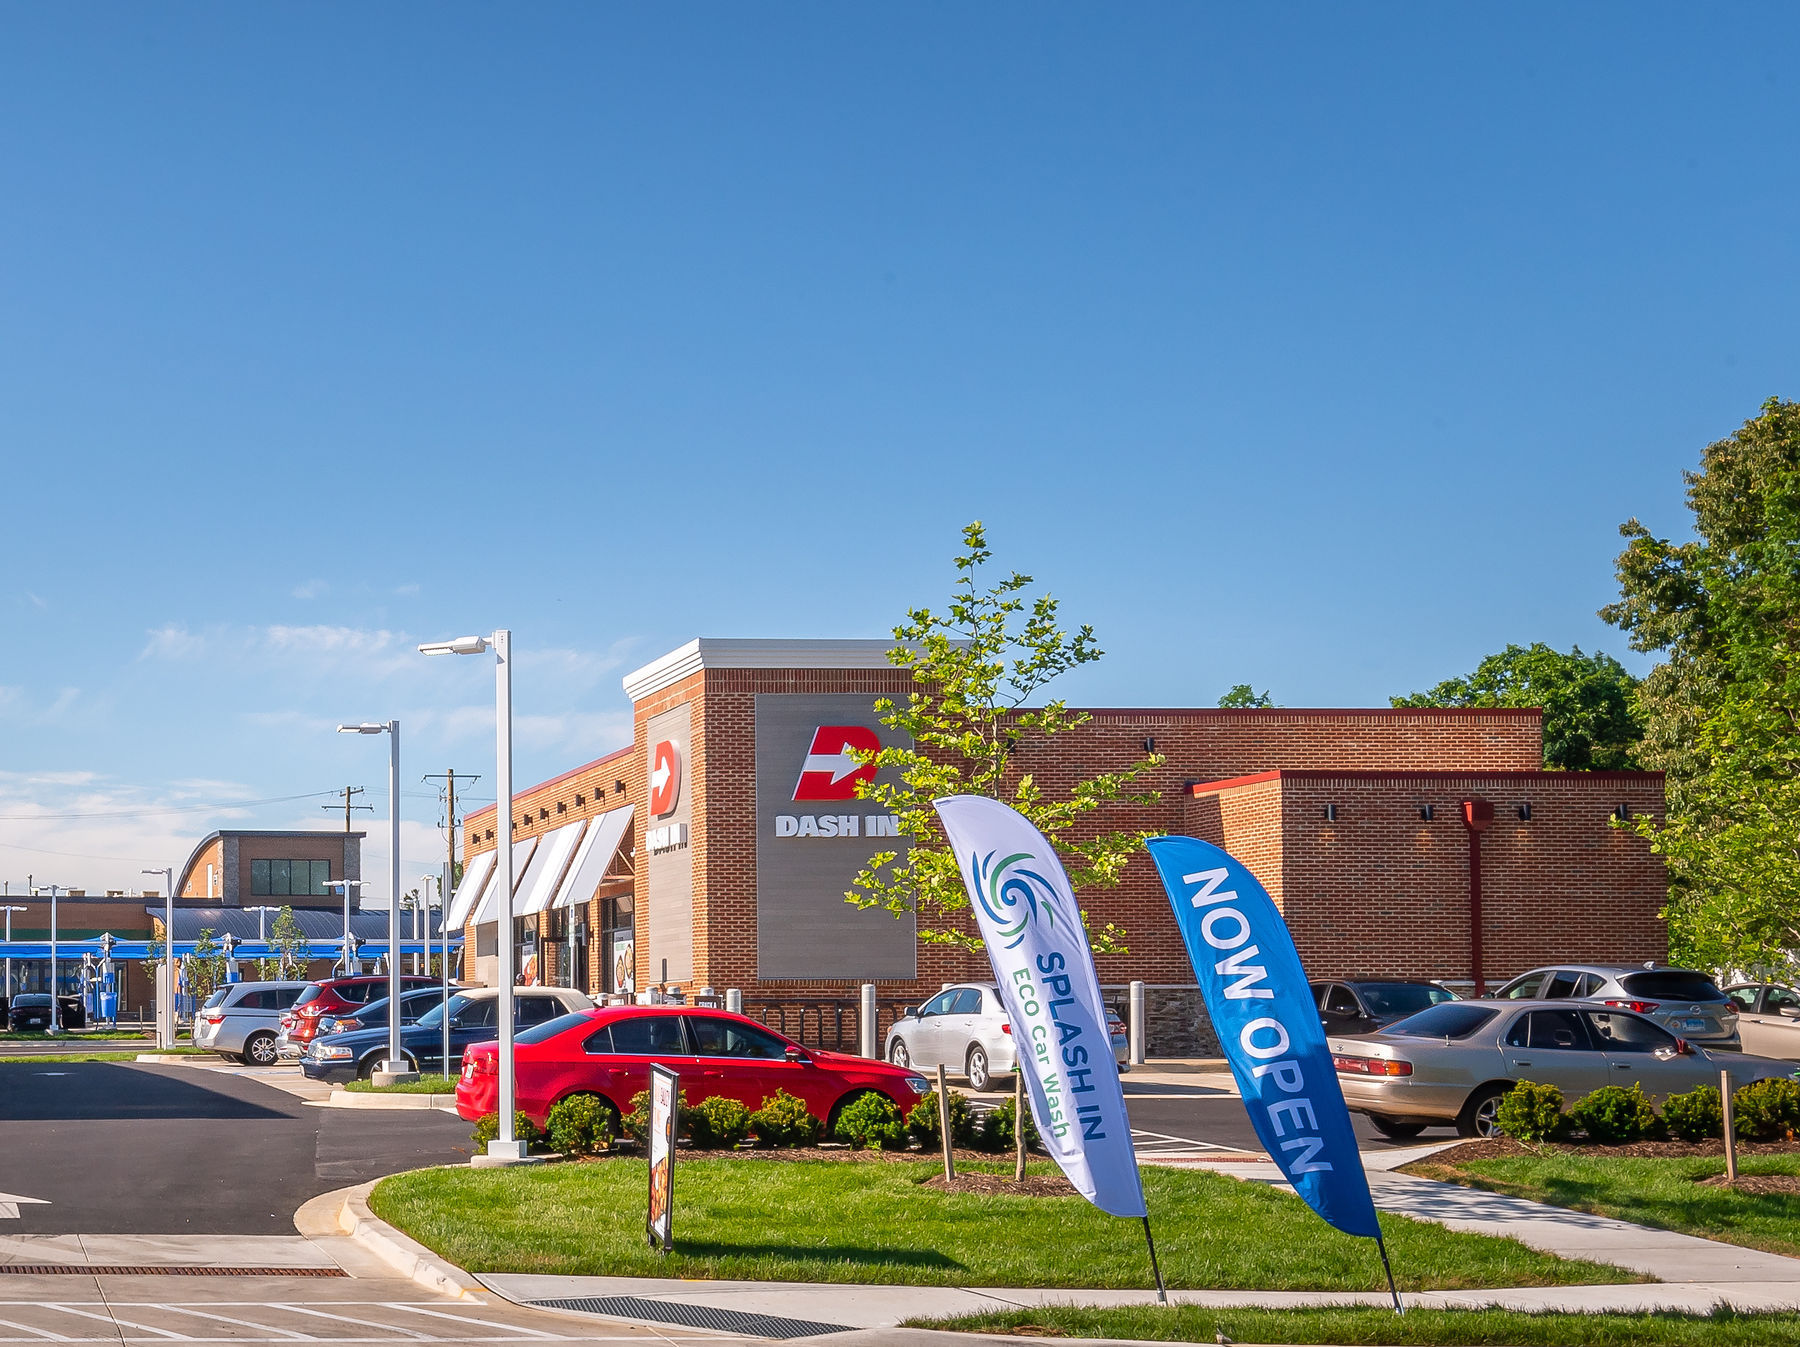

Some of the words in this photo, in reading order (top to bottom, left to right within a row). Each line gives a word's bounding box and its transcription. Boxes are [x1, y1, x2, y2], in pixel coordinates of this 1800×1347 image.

[775, 815, 860, 837] DASH
[865, 815, 899, 837] IN
[1032, 1025, 1050, 1065] Car
[1043, 1072, 1071, 1138] Wash
[1036, 952, 1096, 1094] SPLASH
[1076, 1104, 1107, 1141] IN
[1182, 866, 1275, 1000] NOW
[1239, 1017, 1334, 1176] OPEN
